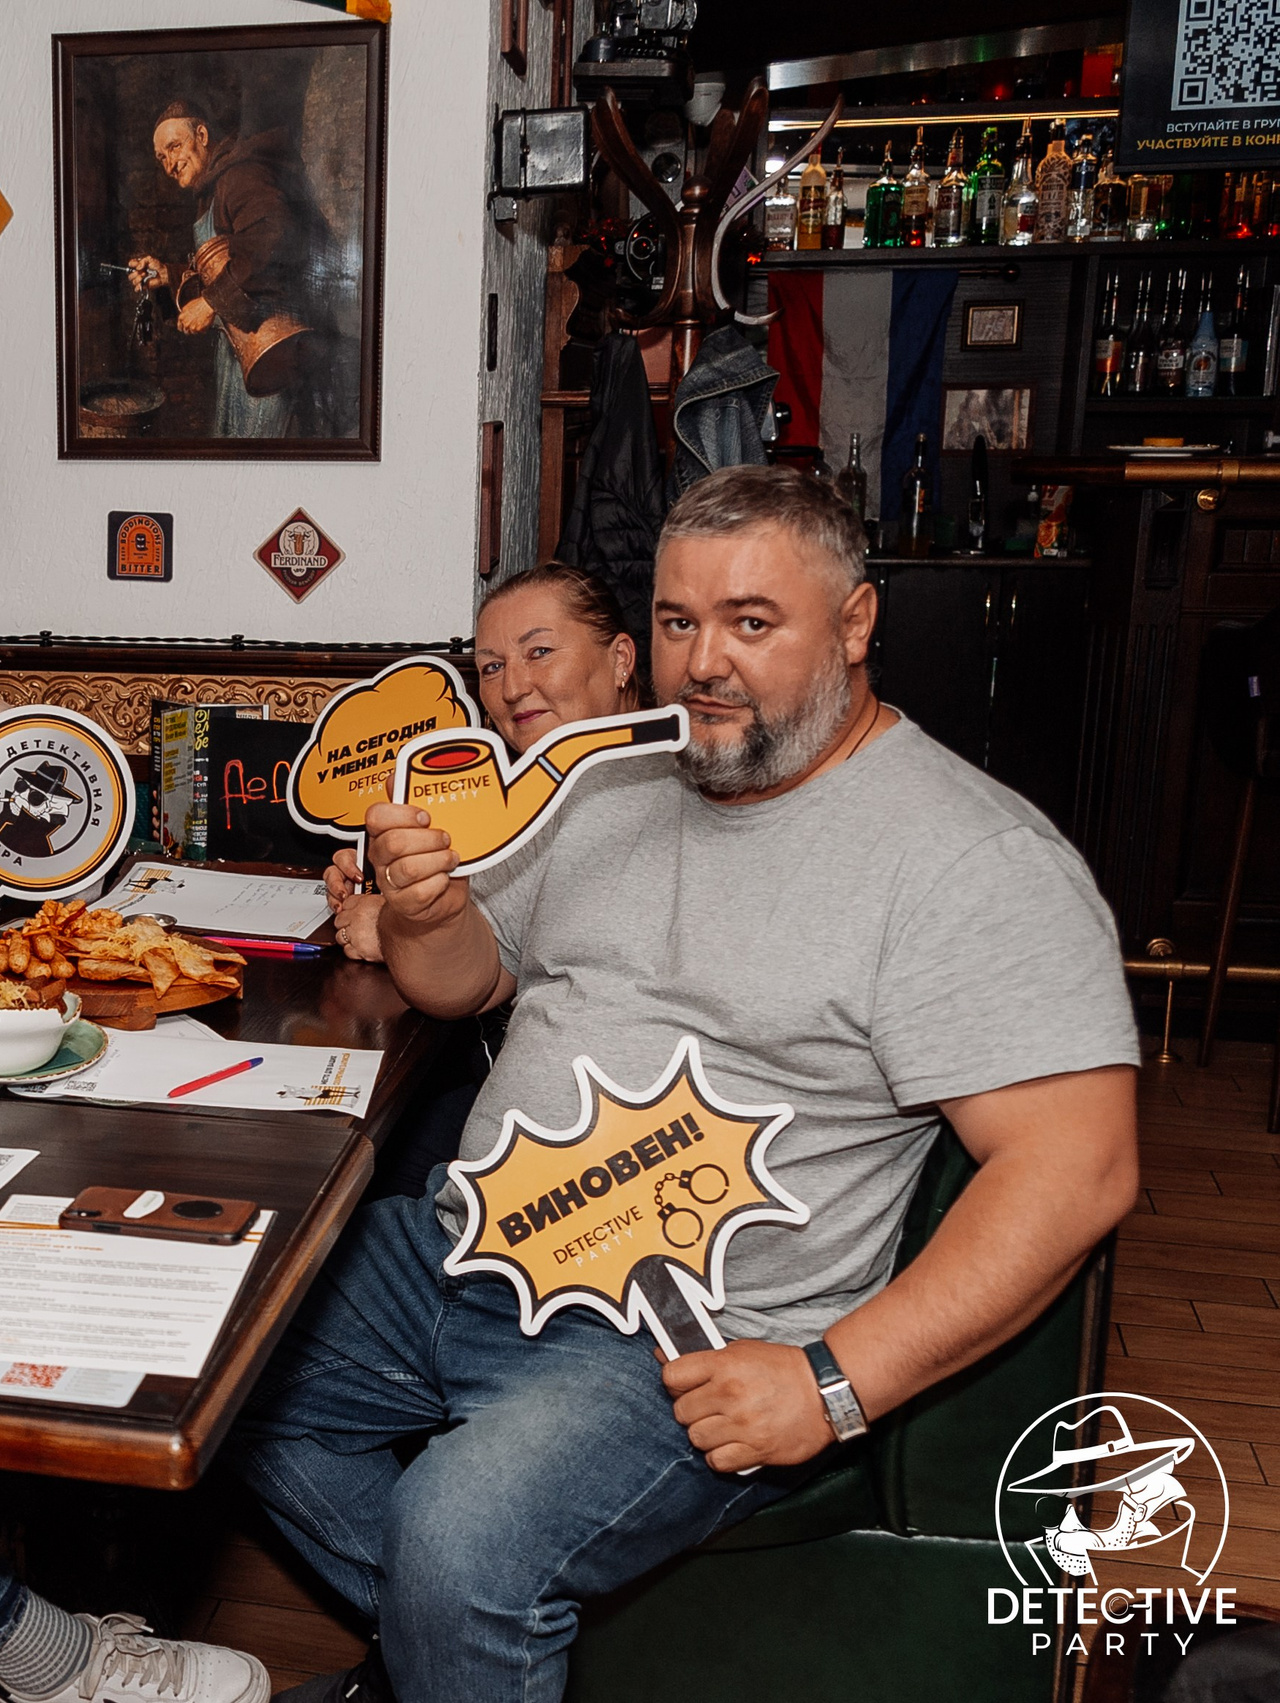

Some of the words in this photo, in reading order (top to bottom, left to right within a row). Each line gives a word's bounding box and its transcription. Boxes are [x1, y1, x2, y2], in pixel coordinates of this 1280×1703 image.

[1166, 119, 1239, 133] ВСТУПАЙТЕ
[1242, 120, 1251, 130] В
[1136, 135, 1229, 150] УЧАСТВУЙТЕ
[1232, 136, 1242, 146] В
[120, 518, 162, 546] BODDINGTONS
[120, 563, 160, 574] BITTER
[273, 554, 327, 567] FERDINAND
[326, 744, 353, 764] НА
[356, 716, 438, 754] СЕГОДНЯ
[317, 768, 330, 784] У
[331, 752, 379, 780] МЕНЯ
[5, 739, 103, 828] ДЕТЕКТИВНАЯ
[413, 774, 490, 798] DETECTIVE
[427, 789, 478, 806] PARTY
[496, 1112, 705, 1249] ВИНОВЕН!
[552, 1205, 644, 1266] DETECTIVE
[573, 1227, 636, 1269] PARTY
